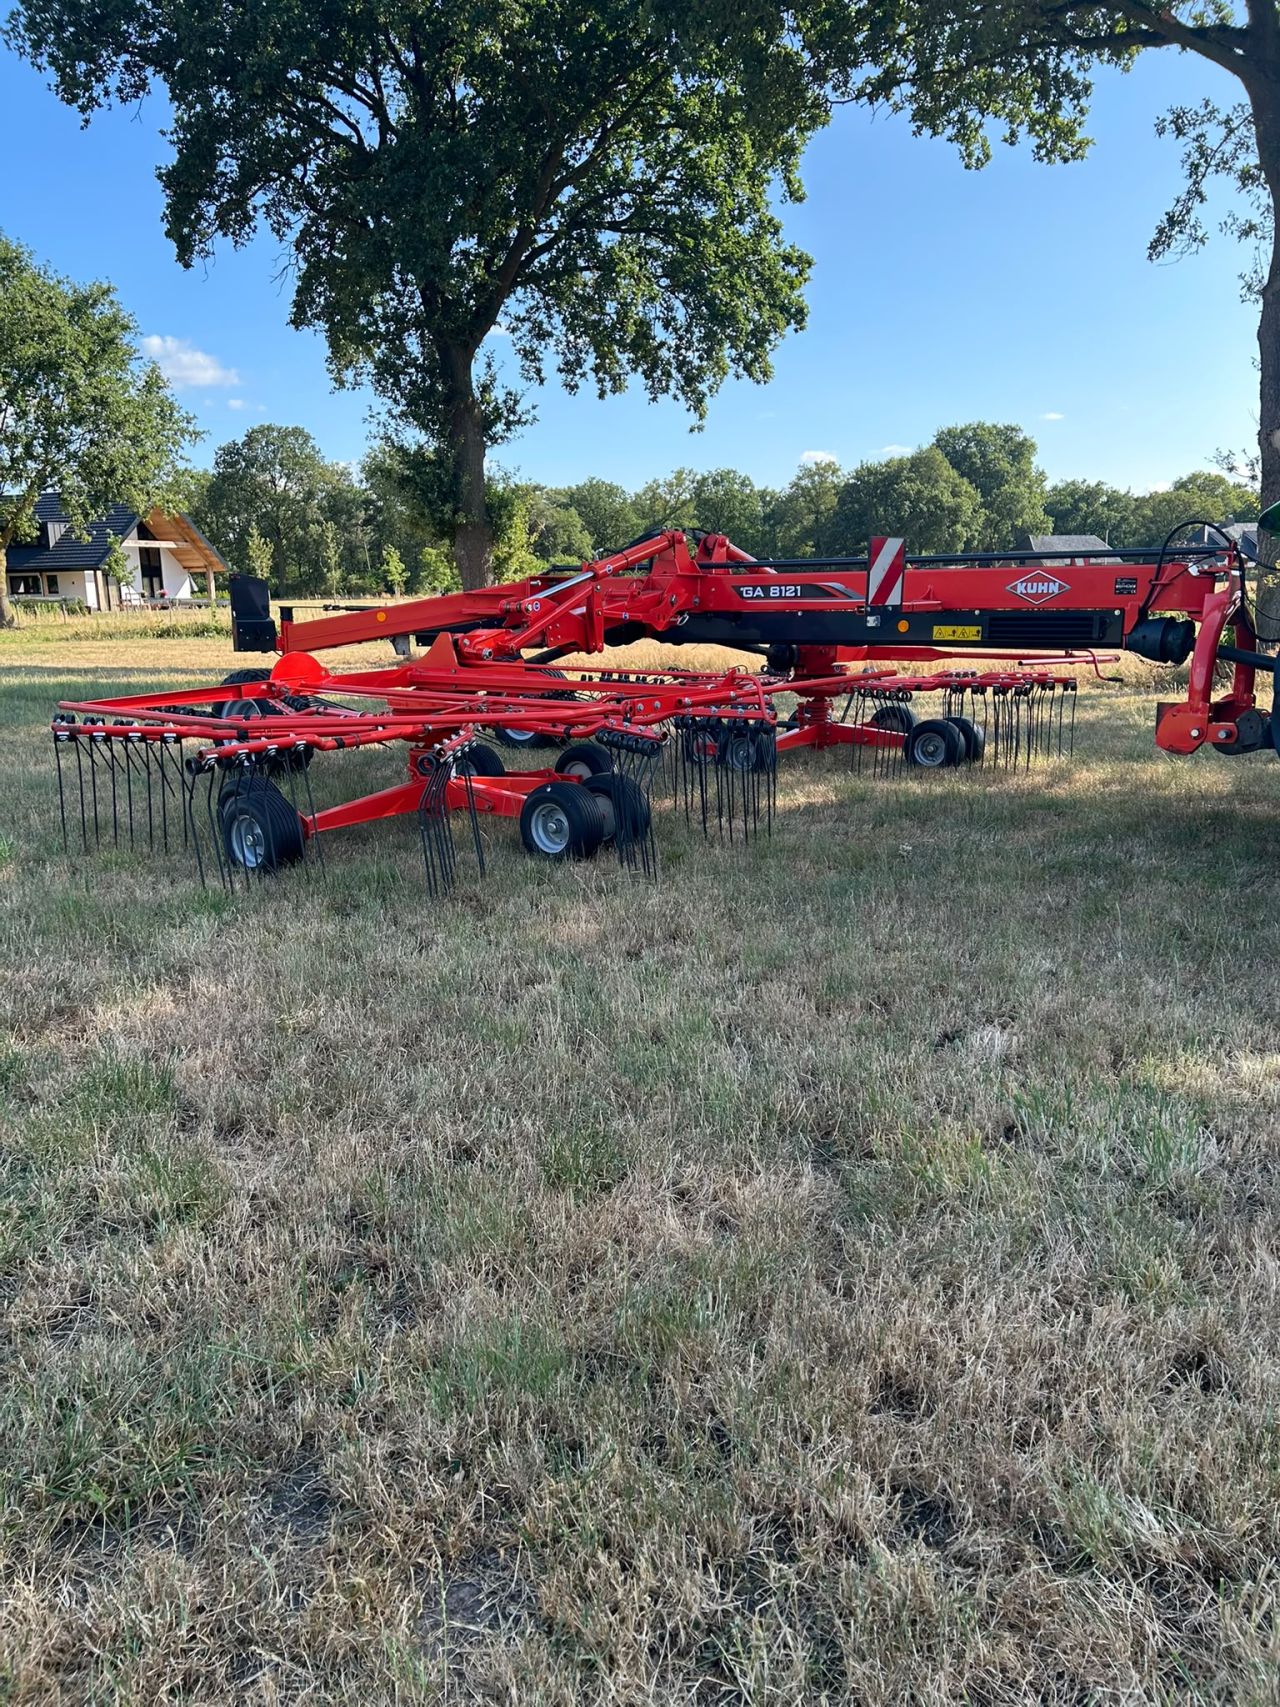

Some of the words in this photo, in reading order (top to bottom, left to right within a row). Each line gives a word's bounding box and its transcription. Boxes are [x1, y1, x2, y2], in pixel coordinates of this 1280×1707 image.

[741, 586, 764, 598] GA
[769, 585, 801, 597] 8121
[1016, 582, 1059, 594] KUHN
